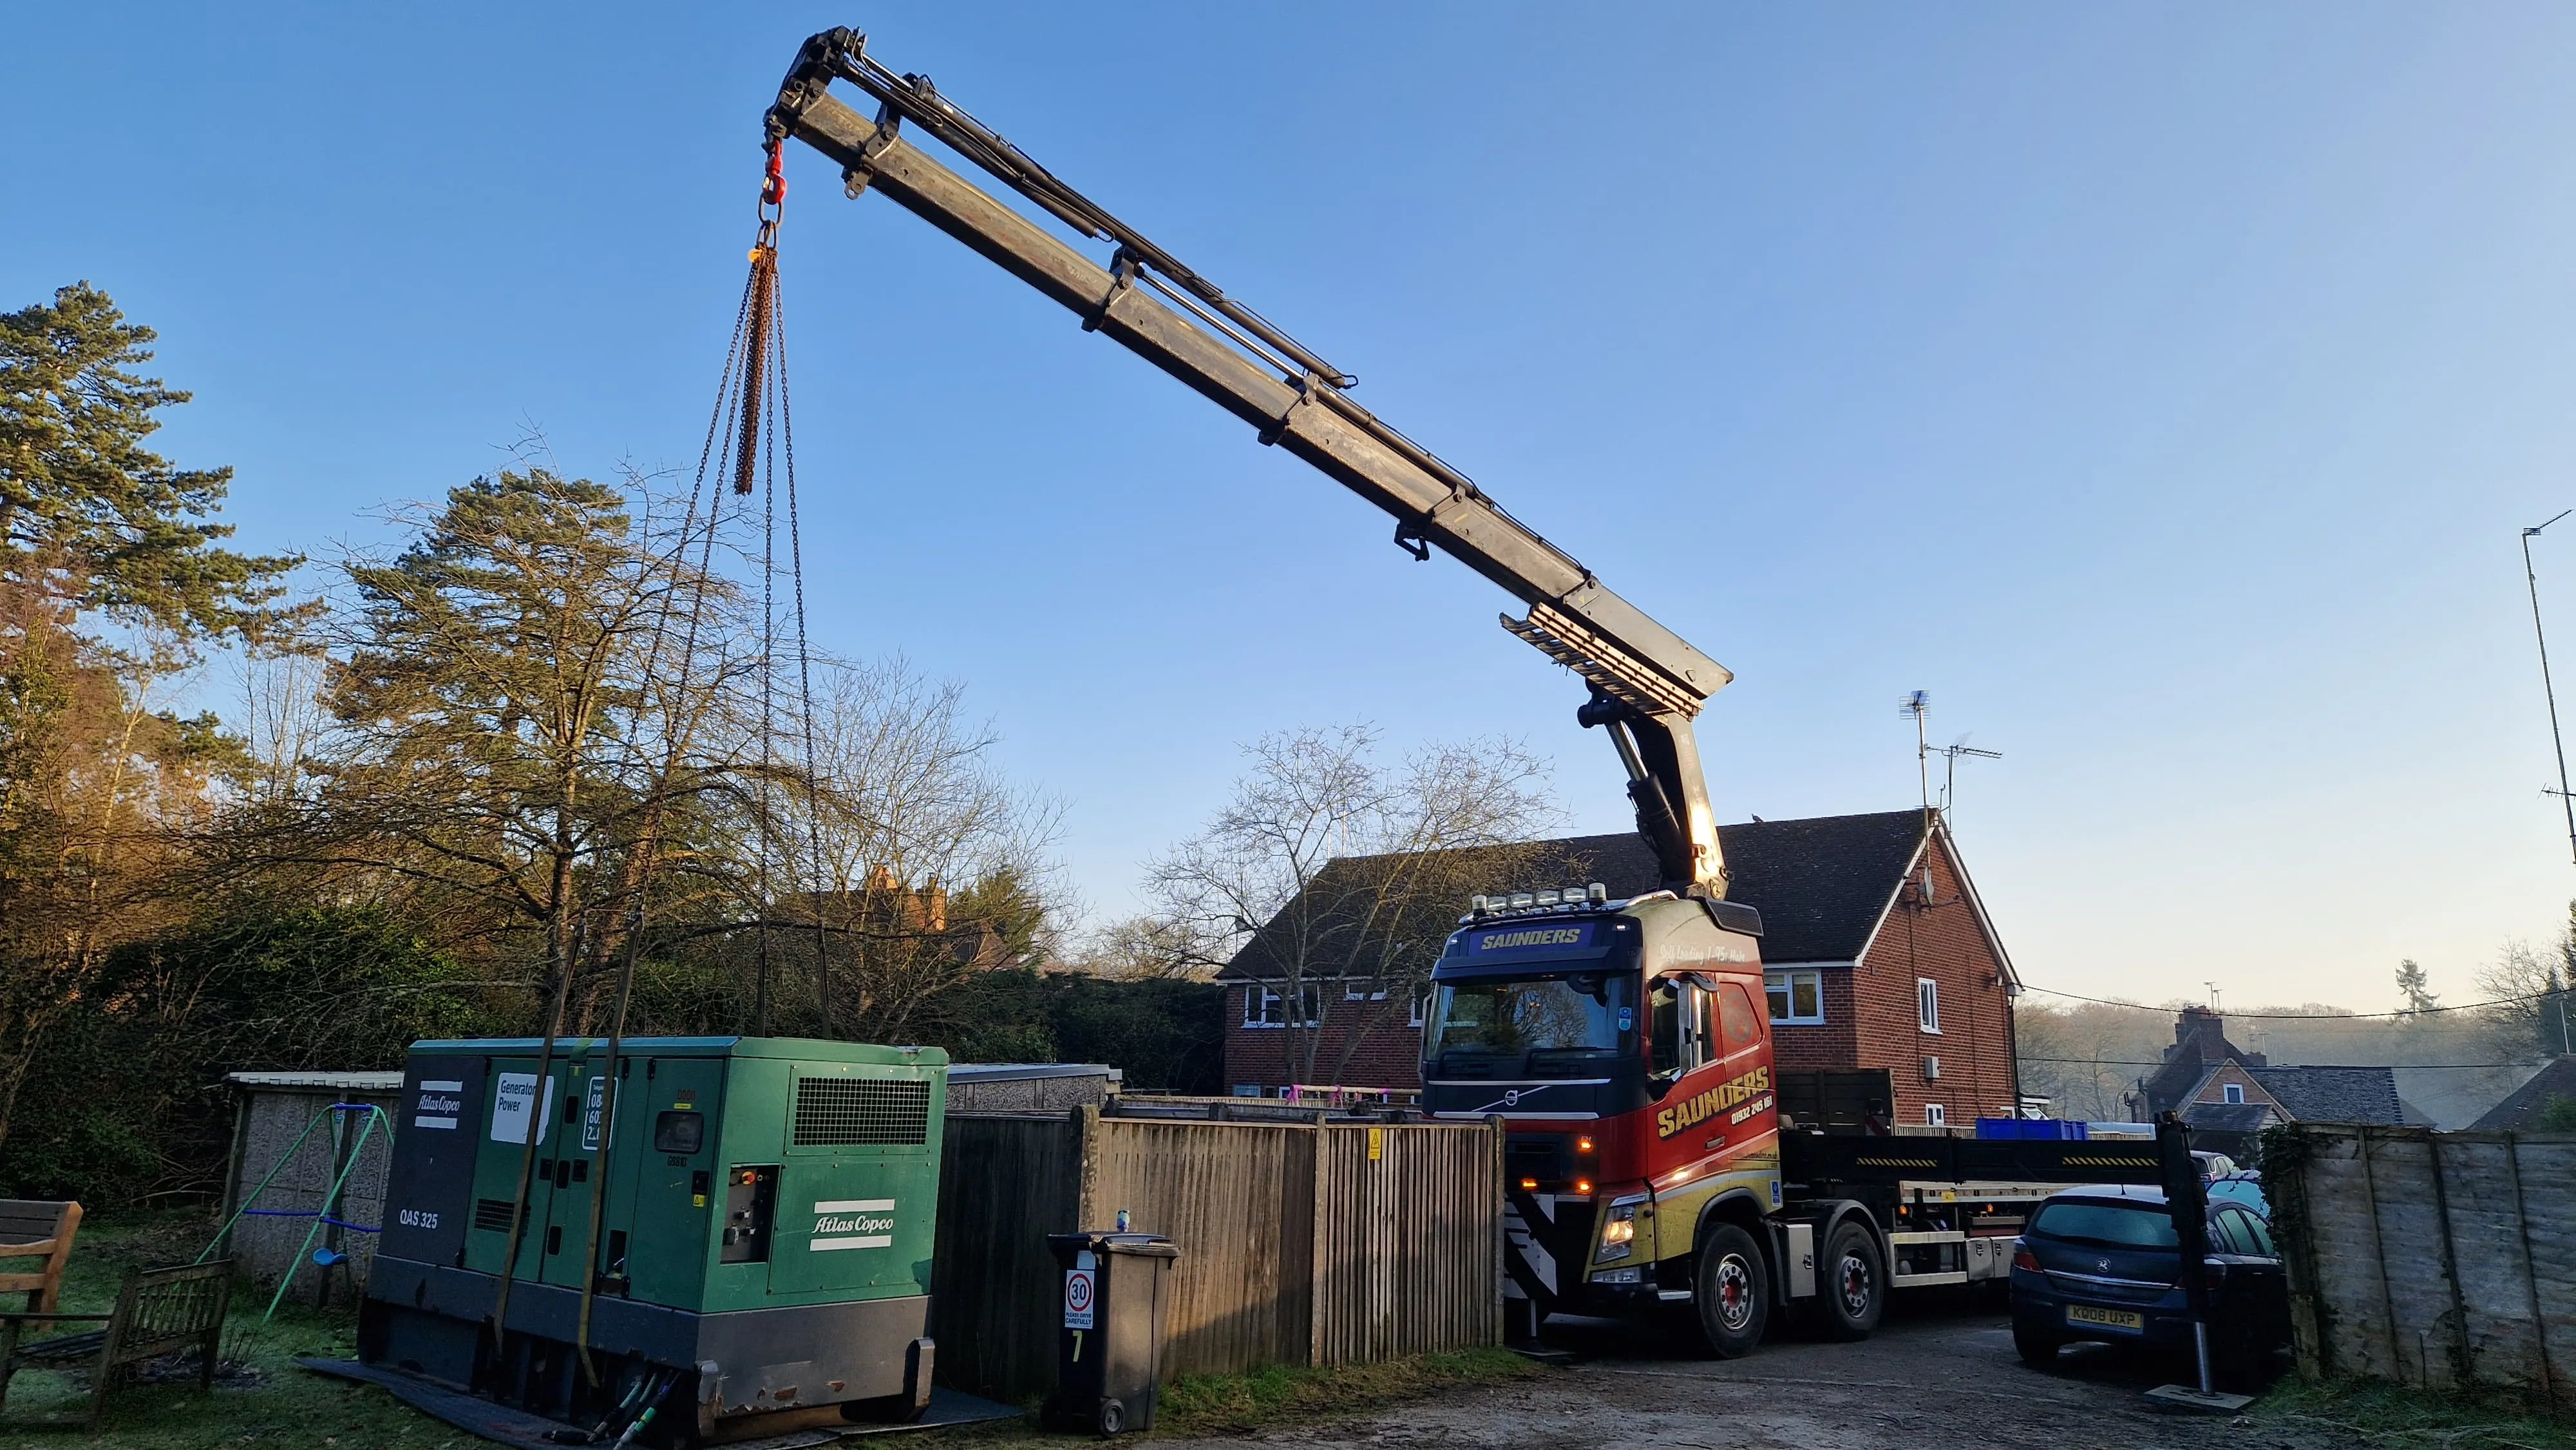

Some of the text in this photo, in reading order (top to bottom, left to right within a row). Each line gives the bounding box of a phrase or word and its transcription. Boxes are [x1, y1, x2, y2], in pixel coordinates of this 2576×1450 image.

[1481, 928, 1581, 950] SAUNDERS
[500, 1080, 537, 1095] Generator
[416, 1094, 460, 1115] Atlas Copco
[498, 1097, 521, 1112] Power
[591, 1093, 603, 1108] 08
[1658, 1065, 1770, 1138] SAUNDERS
[1731, 1095, 1773, 1125] 01932 245 161
[400, 1209, 438, 1229] QAS 325
[811, 1215, 894, 1234] Atlas Copco
[1072, 1283, 1087, 1300] 30
[2110, 1310, 2136, 1324] UXP
[1072, 1330, 1082, 1362] 7
